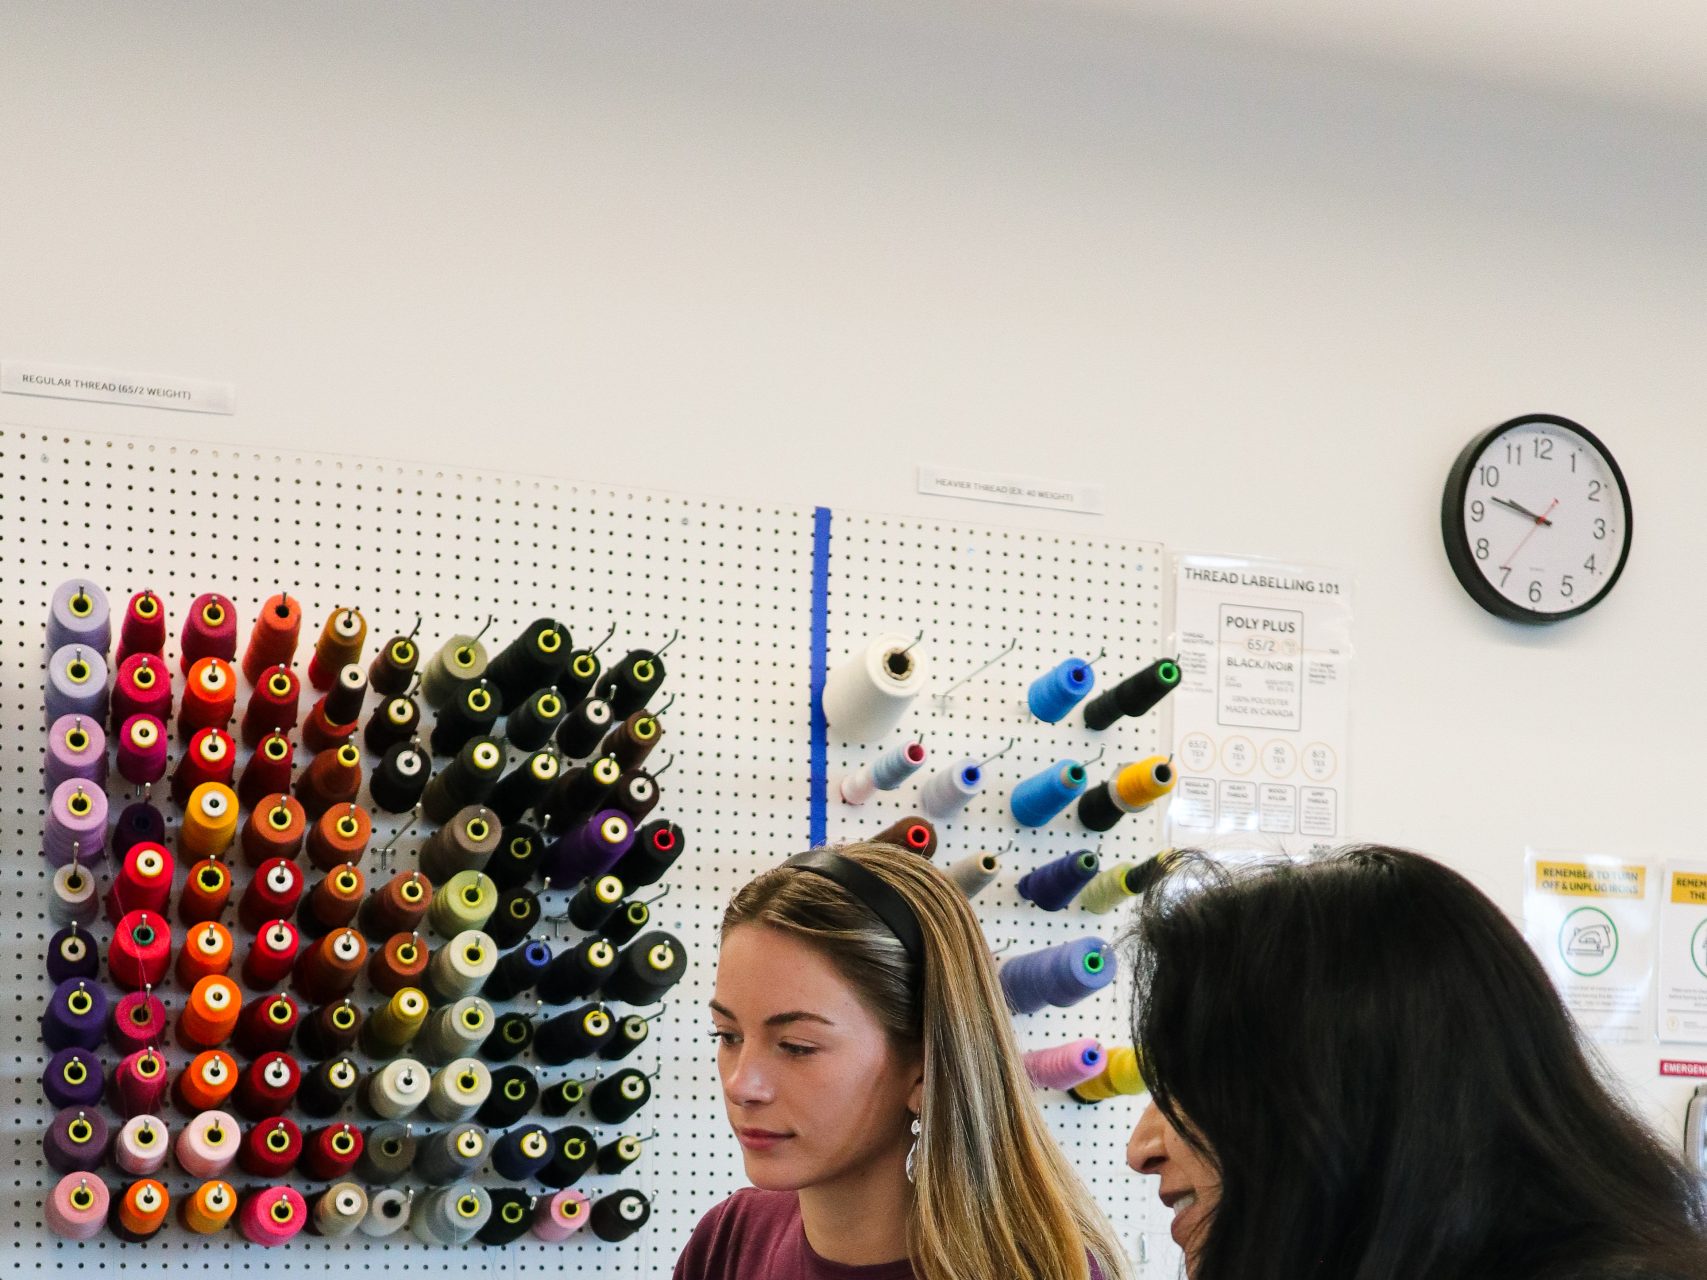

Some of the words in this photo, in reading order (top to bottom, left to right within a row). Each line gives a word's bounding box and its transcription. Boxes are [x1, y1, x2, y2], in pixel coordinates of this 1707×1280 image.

[22, 373, 71, 388] REGULAR
[74, 379, 116, 392] THREAD
[118, 384, 145, 396] (65/2
[146, 387, 191, 400] WEIGHT)
[1507, 443, 1521, 465] 11
[1534, 437, 1553, 460] 12
[1570, 452, 1576, 473] 1
[935, 478, 971, 489] HEAVIER
[974, 482, 1008, 494] THREAD
[1479, 465, 1499, 487] 10
[1588, 480, 1600, 502] 2
[1471, 500, 1484, 522] 9
[1593, 518, 1605, 540] 3
[1476, 538, 1489, 560] 8
[1584, 554, 1596, 575] 4
[1184, 567, 1238, 585] THREAD
[1242, 574, 1315, 592] LABELLING
[1319, 583, 1340, 595] 101
[1499, 566, 1512, 587] 7
[1560, 575, 1573, 597] 5
[1529, 581, 1542, 603] 6
[1226, 616, 1259, 630] POLY
[1263, 618, 1295, 633] PLUS
[1247, 638, 1276, 651] 65/2
[1227, 657, 1294, 672] BLACK/NOIR
[1543, 867, 1594, 878] REMEMBER
[1570, 882, 1607, 892] UNPLUG
[1663, 1062, 1707, 1075] EMERGEN
